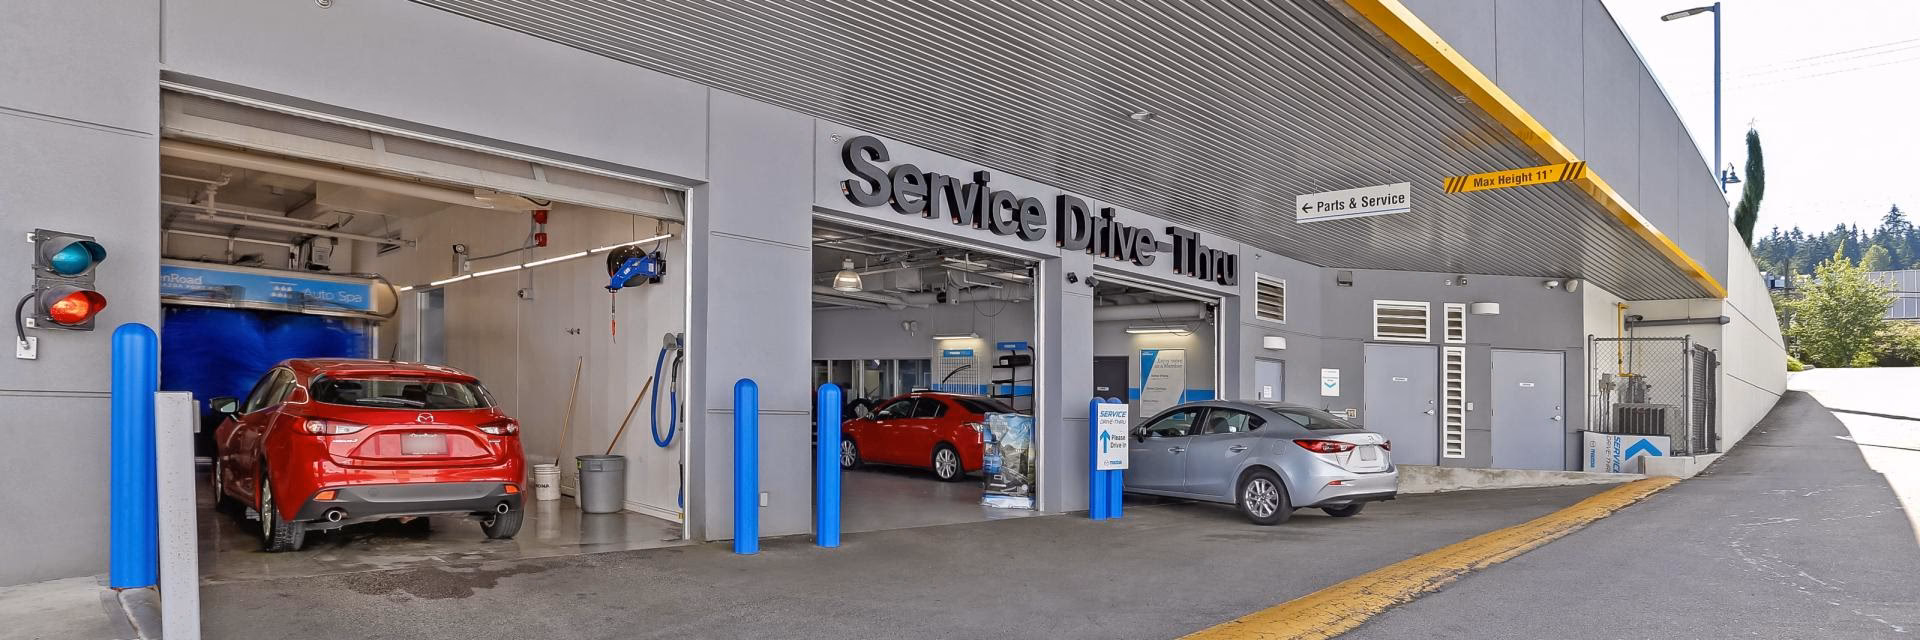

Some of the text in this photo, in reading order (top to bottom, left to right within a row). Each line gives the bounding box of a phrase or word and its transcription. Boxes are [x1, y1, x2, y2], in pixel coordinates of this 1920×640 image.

[1473, 178, 1495, 187] Max
[1498, 172, 1532, 185] Height
[1317, 193, 1405, 212] Parts & Service
[841, 135, 1238, 286] Service Drive-Thru
[338, 290, 362, 303] Spa
[1099, 410, 1127, 418] SERVICE
